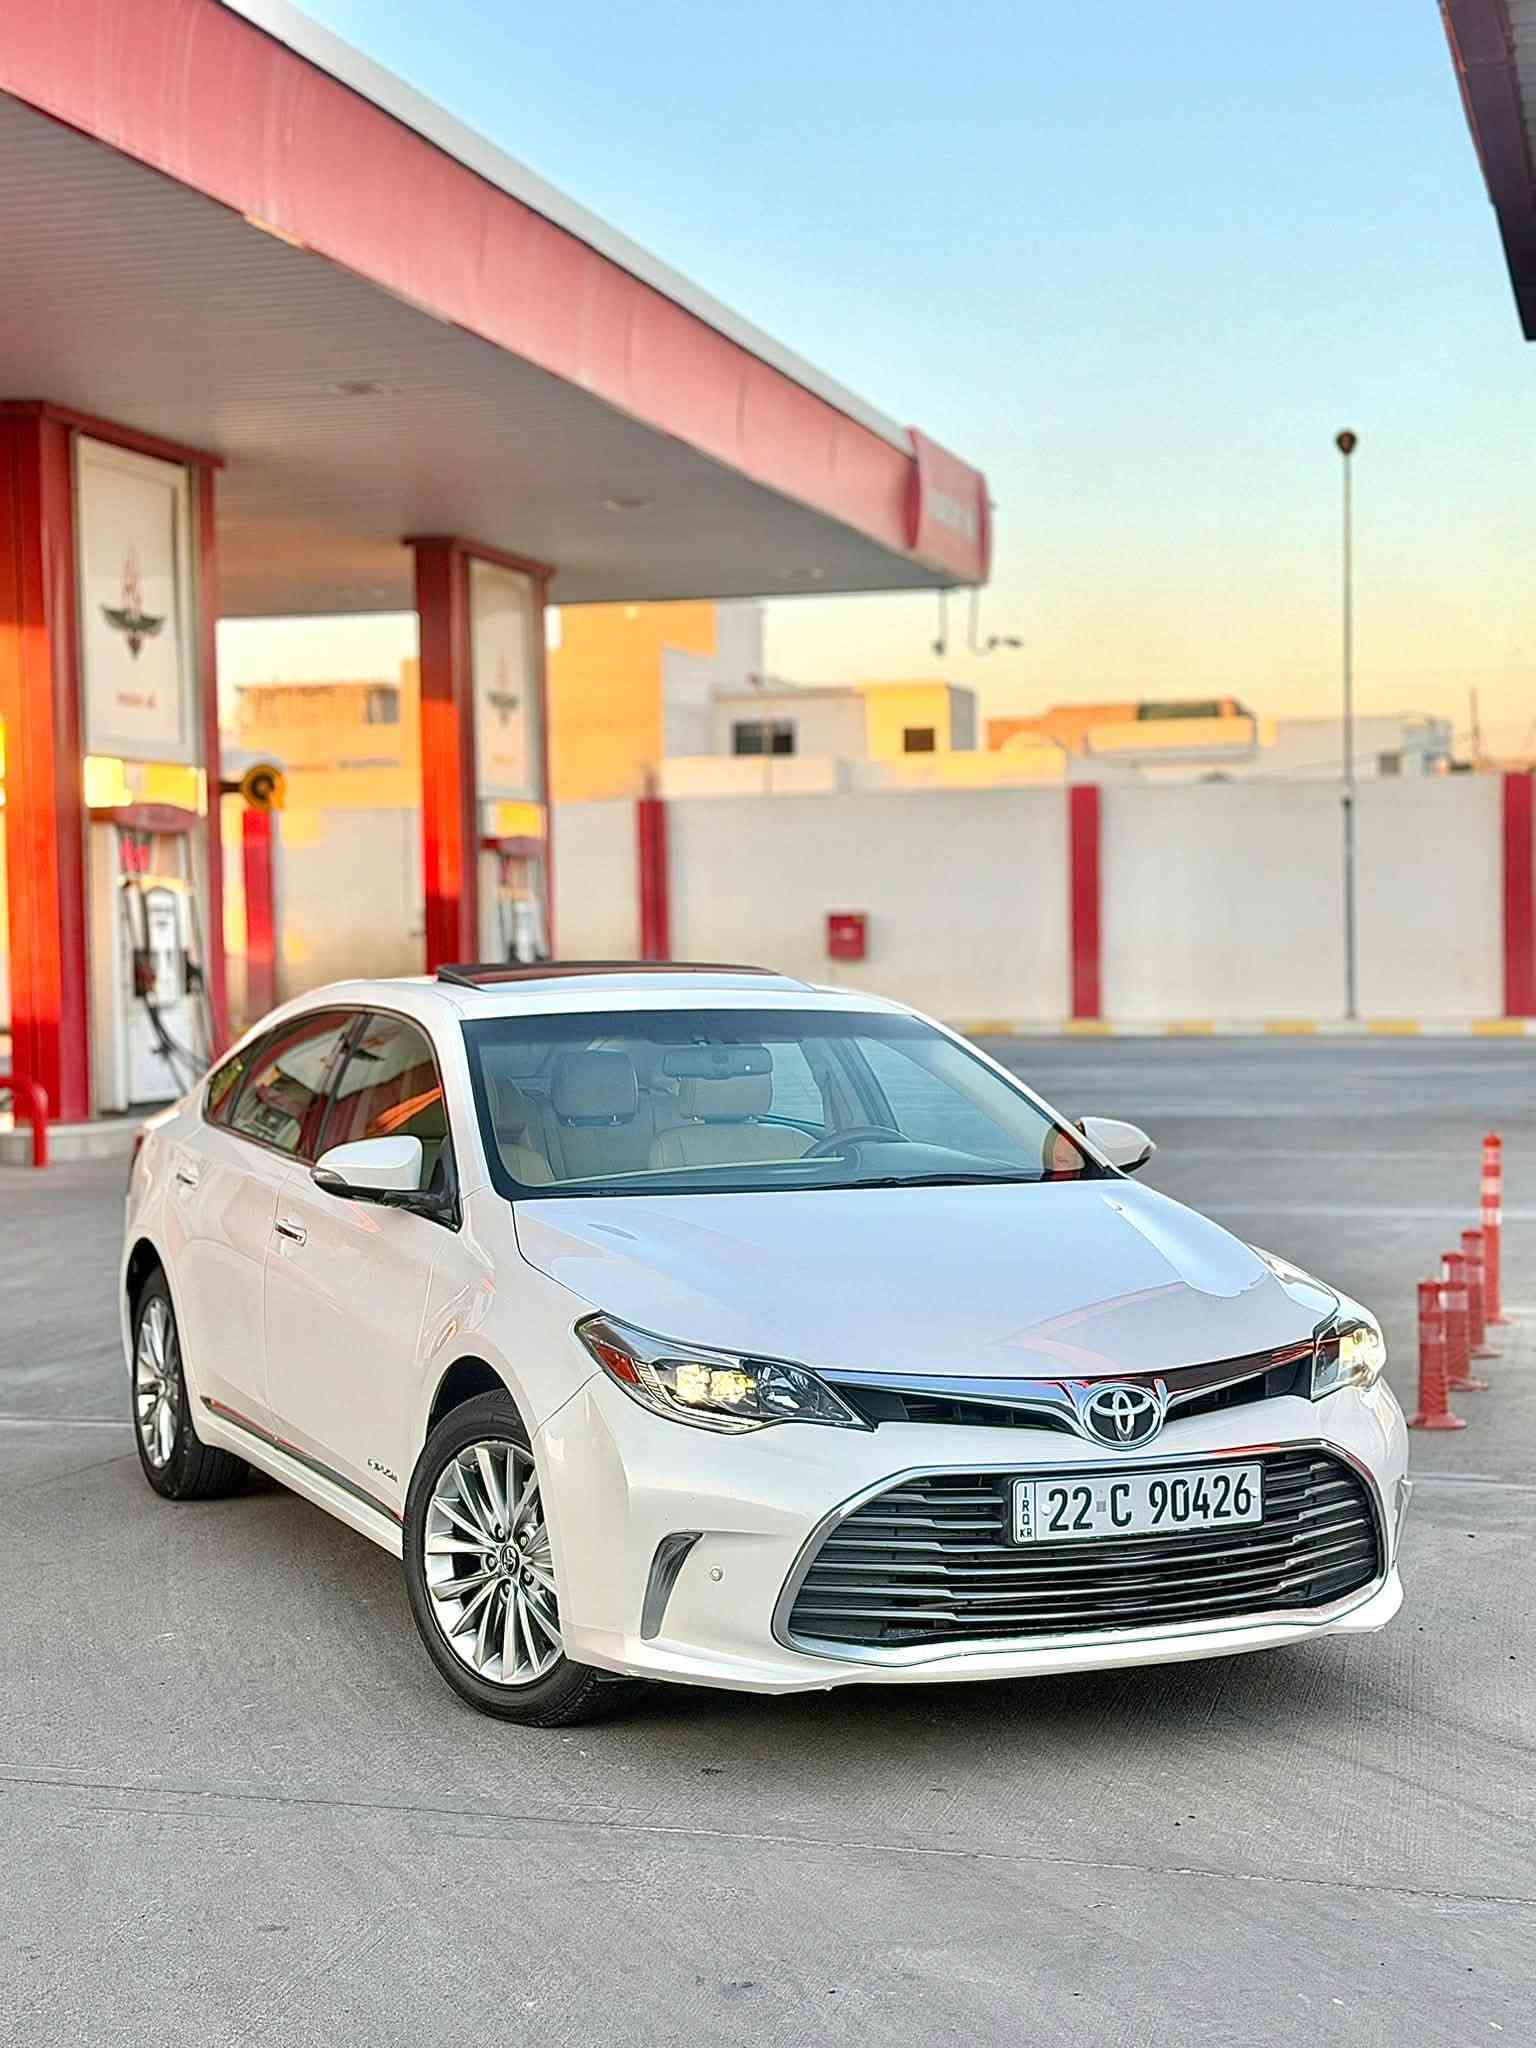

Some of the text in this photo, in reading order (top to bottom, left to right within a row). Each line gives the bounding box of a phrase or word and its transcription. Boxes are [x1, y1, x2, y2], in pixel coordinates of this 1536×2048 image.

[1048, 1473, 1251, 1531] 22 C 90426
